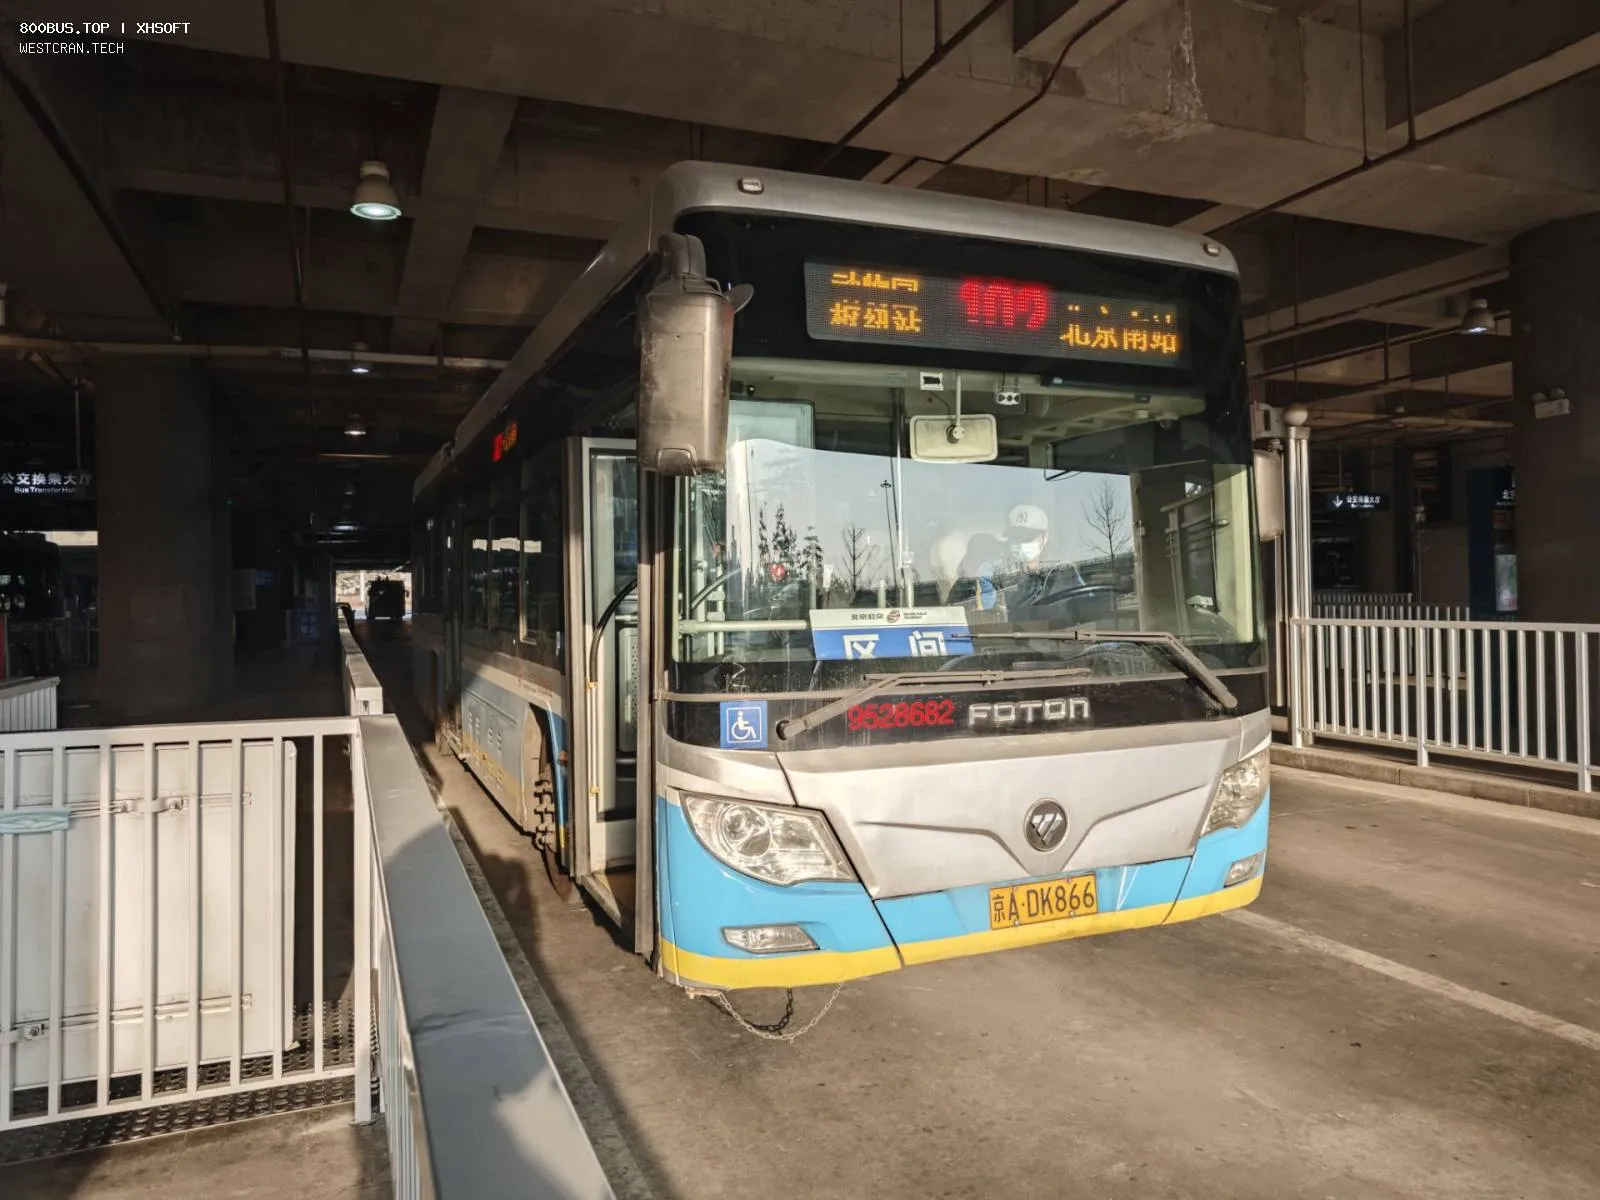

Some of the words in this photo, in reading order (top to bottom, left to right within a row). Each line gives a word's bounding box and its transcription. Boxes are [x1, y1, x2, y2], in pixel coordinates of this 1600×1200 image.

[0, 472, 93, 486] 公交换乘大厅
[848, 699, 956, 731] 9528682
[968, 697, 1091, 726] FOTON
